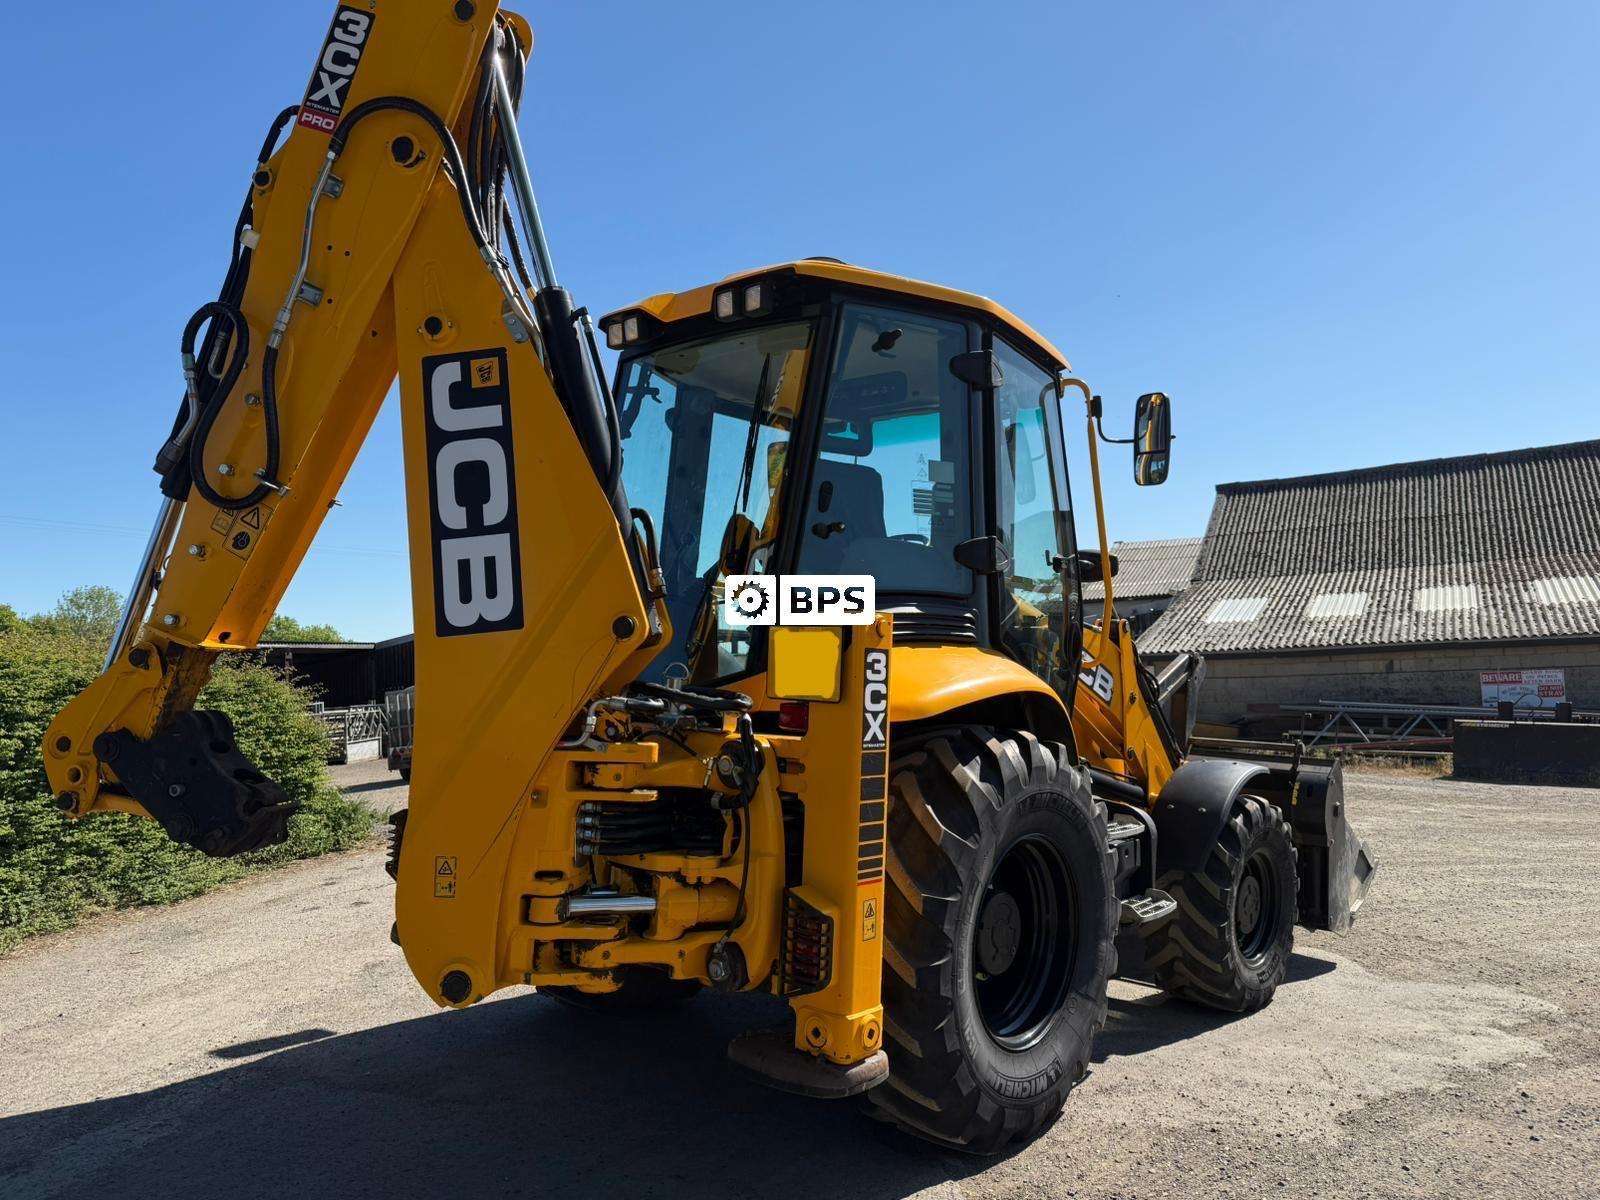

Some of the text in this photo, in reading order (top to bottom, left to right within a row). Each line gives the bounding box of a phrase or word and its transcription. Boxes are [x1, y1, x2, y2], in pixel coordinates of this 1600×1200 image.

[308, 11, 370, 108] 3CX
[302, 112, 336, 130] PRO
[431, 361, 514, 627] JCB
[862, 652, 887, 742] 3CX
[1078, 650, 1114, 702] CB
[1481, 673, 1521, 682] BEWARE
